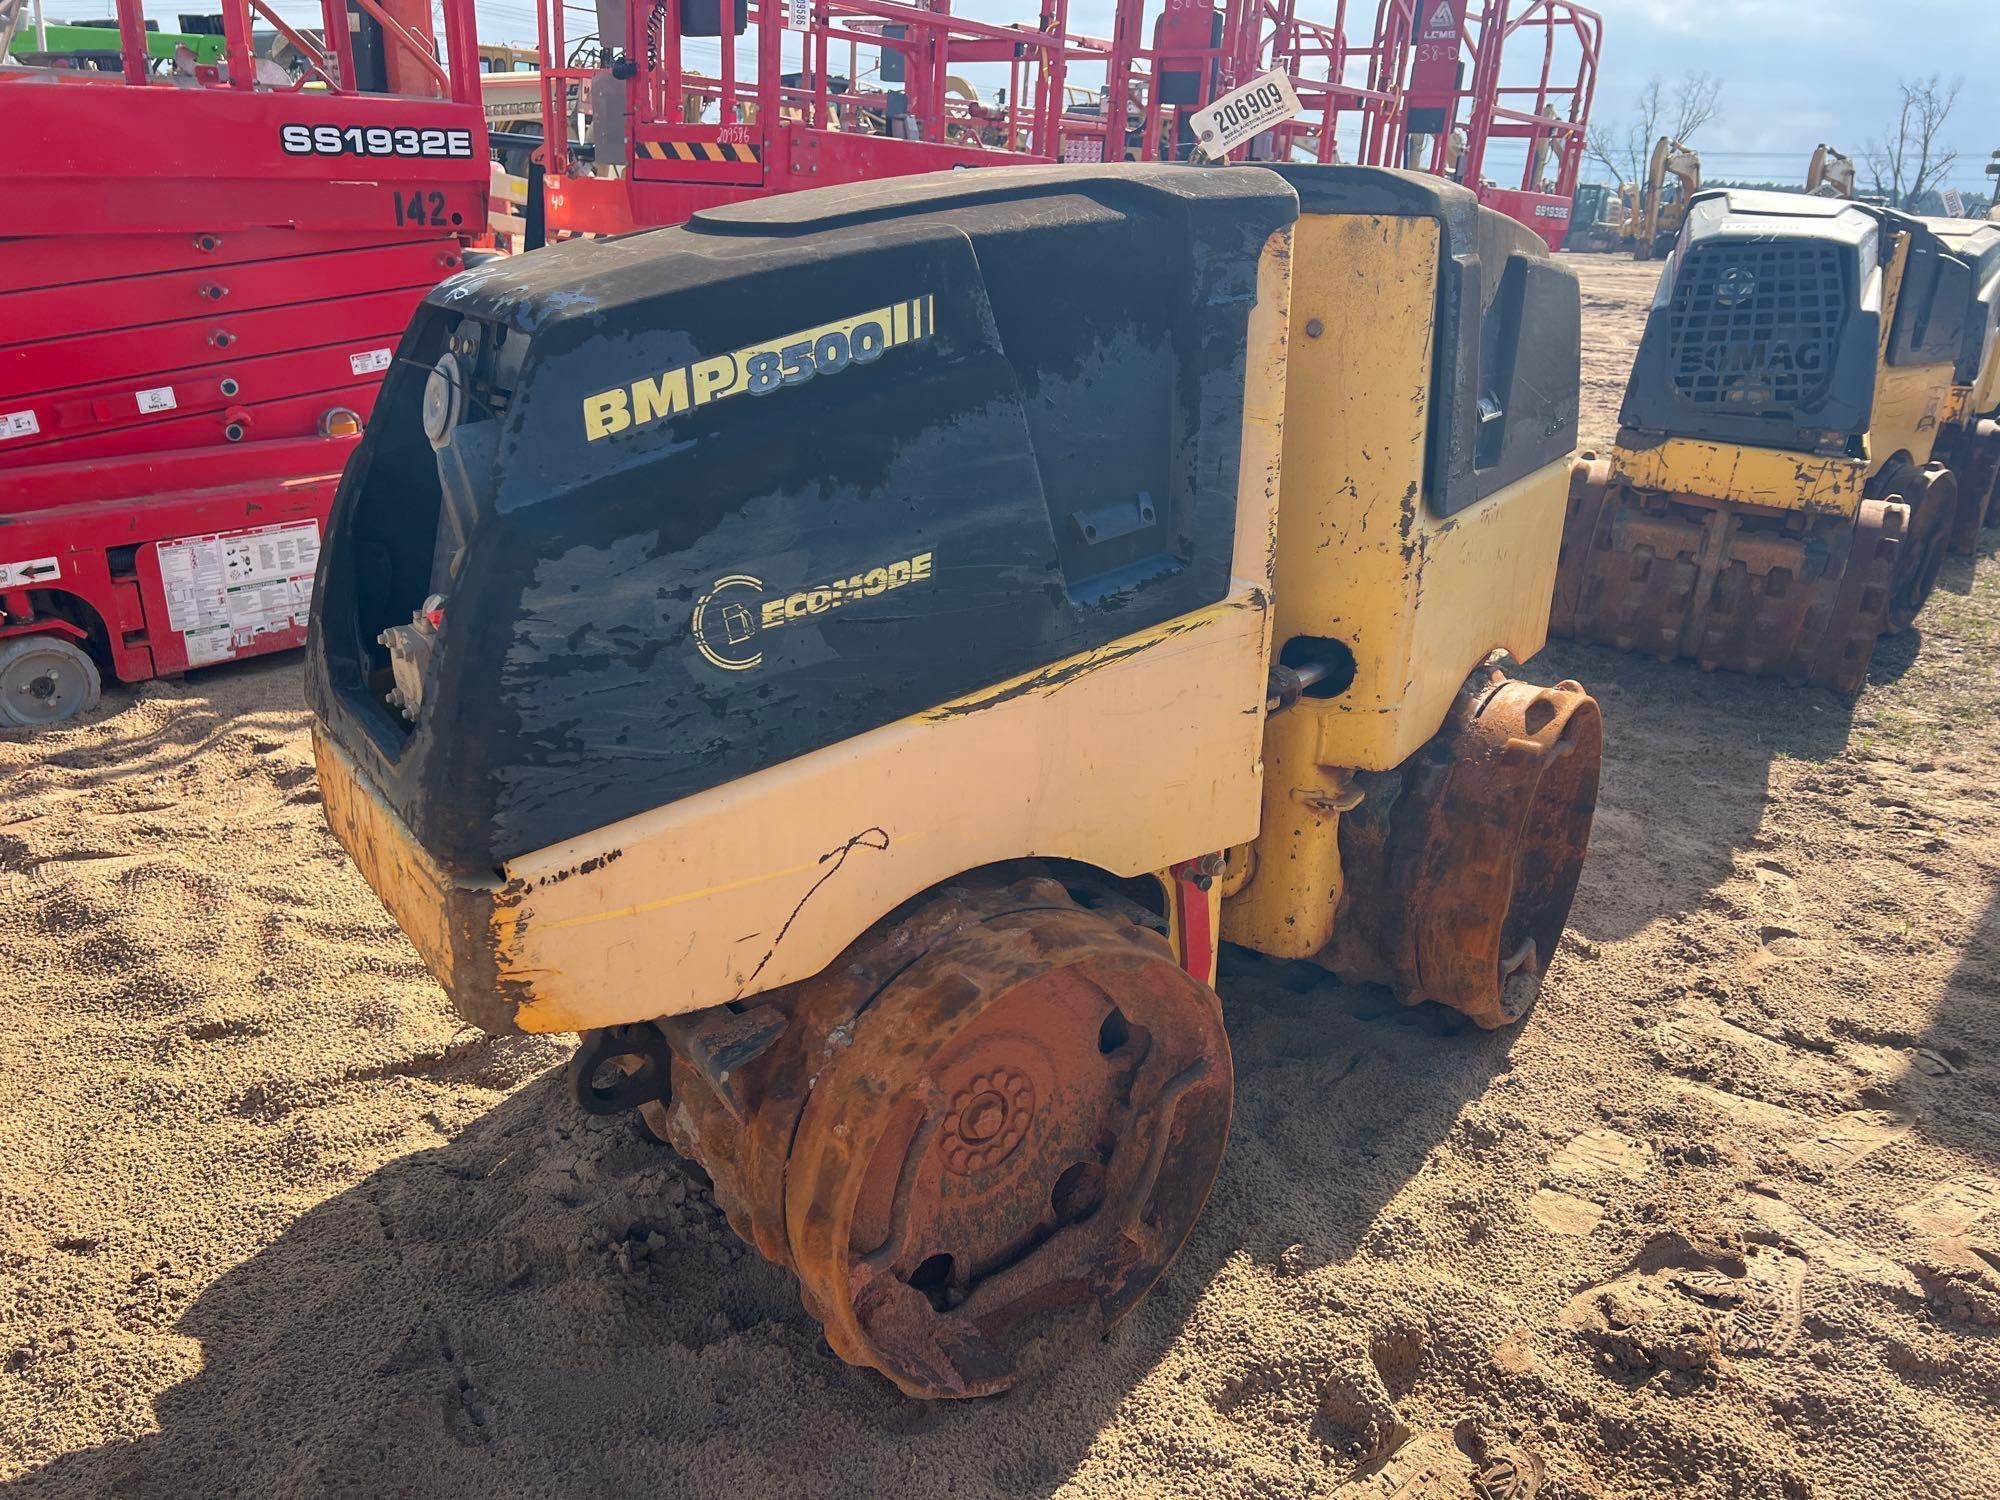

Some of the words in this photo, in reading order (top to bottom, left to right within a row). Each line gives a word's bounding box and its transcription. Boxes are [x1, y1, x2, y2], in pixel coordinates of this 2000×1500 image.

[1423, 30, 1456, 39] LCMG
[1213, 82, 1283, 134] 206909
[1260, 105, 1285, 119] COMPANY
[282, 125, 472, 157] SS1932E
[716, 126, 750, 144] 209586
[761, 551, 932, 630] ECOMODE
